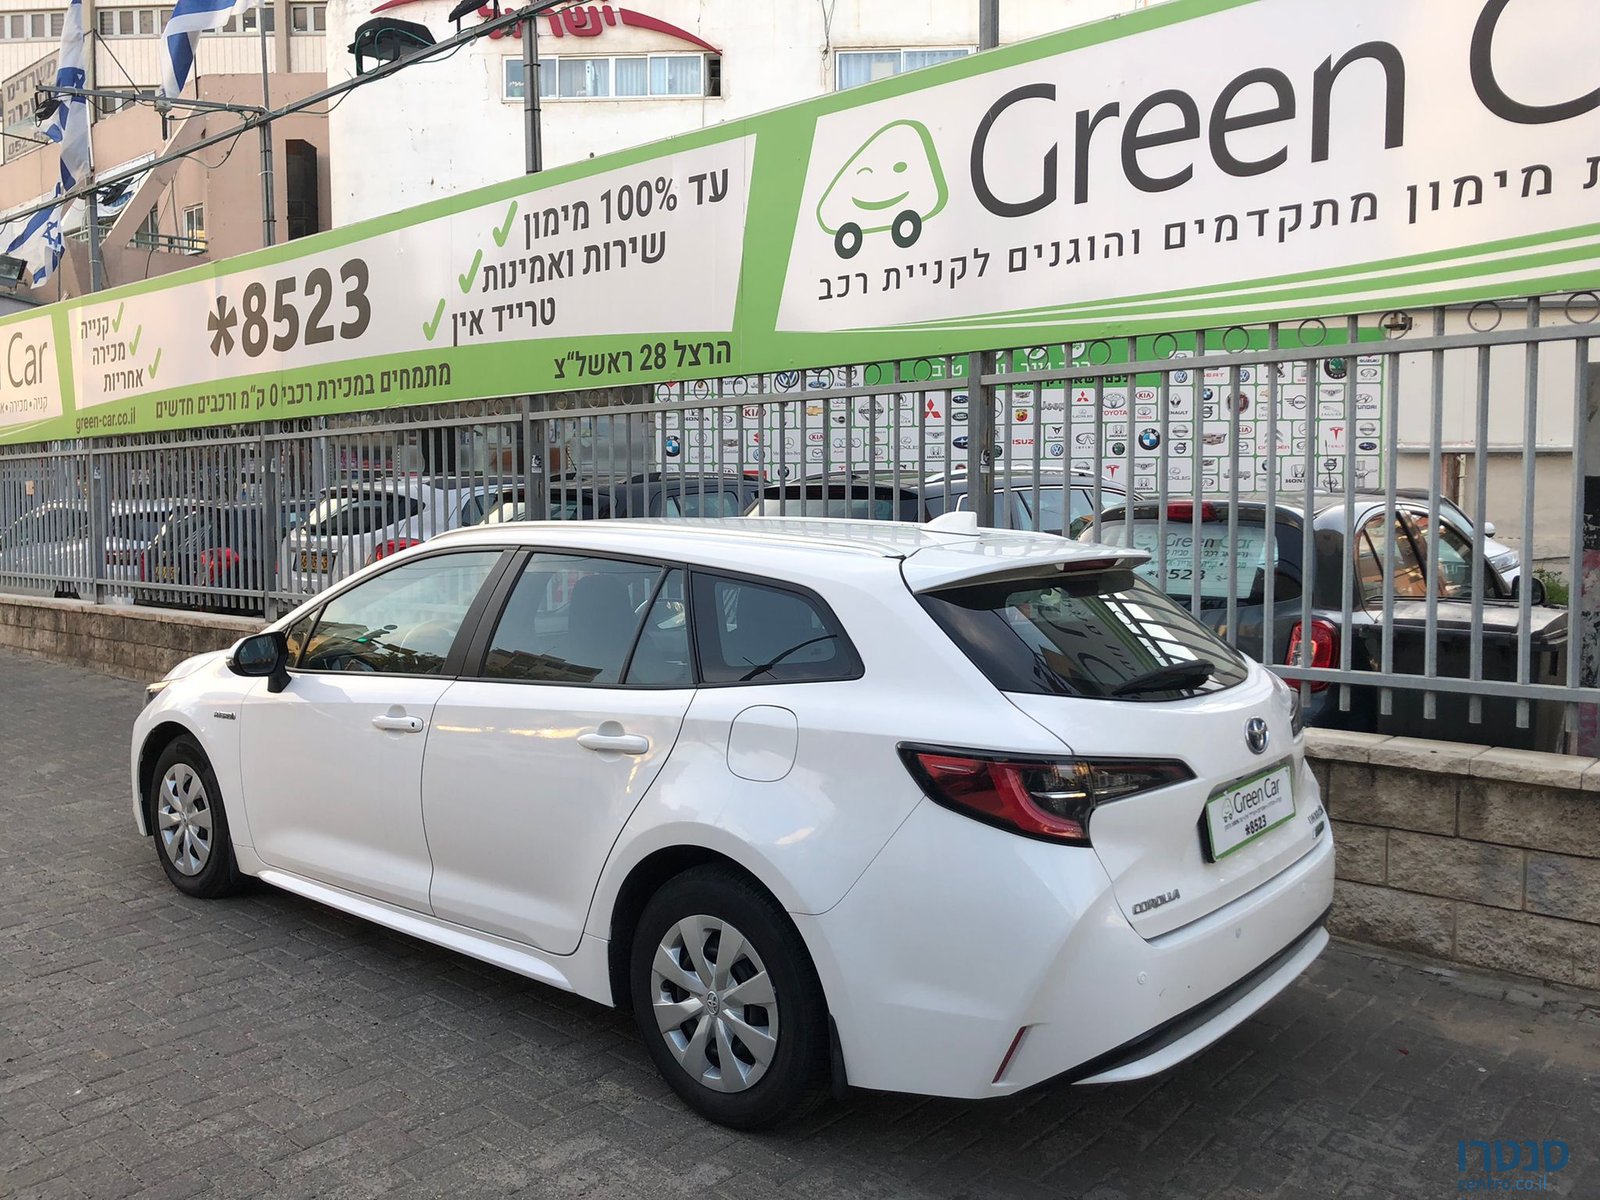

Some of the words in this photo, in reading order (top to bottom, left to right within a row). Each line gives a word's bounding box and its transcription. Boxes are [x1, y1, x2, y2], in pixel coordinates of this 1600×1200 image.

[970, 40, 1405, 218] Green
[1469, 0, 1600, 125] C
[600, 176, 678, 226] 100%
[688, 168, 730, 206] עד
[1406, 164, 1553, 225] מימון
[523, 200, 590, 250] מימון
[1164, 191, 1378, 250] מתקדמים
[582, 230, 667, 276] שירות
[1008, 228, 1141, 273] והוגנים
[482, 248, 574, 294] ואמינות
[882, 247, 991, 291] לקניית
[818, 272, 868, 301] רכב
[80, 316, 110, 342] קנייה
[452, 308, 485, 347] אין
[491, 296, 557, 333] טרייד
[7, 331, 49, 389] Car
[92, 341, 127, 367] מכירה
[553, 350, 633, 380] ראשל"צ
[639, 342, 667, 371] 28
[673, 339, 732, 368] הרצל
[103, 368, 144, 394] אחריות
[316, 373, 375, 402] במכירת
[380, 362, 452, 393] מתמחים
[155, 397, 194, 419] חדשים
[197, 391, 237, 415] ורכבים
[269, 383, 279, 407] 0
[281, 384, 313, 406] רכבי
[1138, 391, 1152, 399] KIA
[75, 406, 136, 434] green-car.co.il
[1103, 409, 1128, 417] OYOTA
[1223, 468, 1252, 481] Jep
[1165, 532, 1215, 548] Gren
[1233, 787, 1264, 814] Green
[1264, 777, 1280, 799] Car
